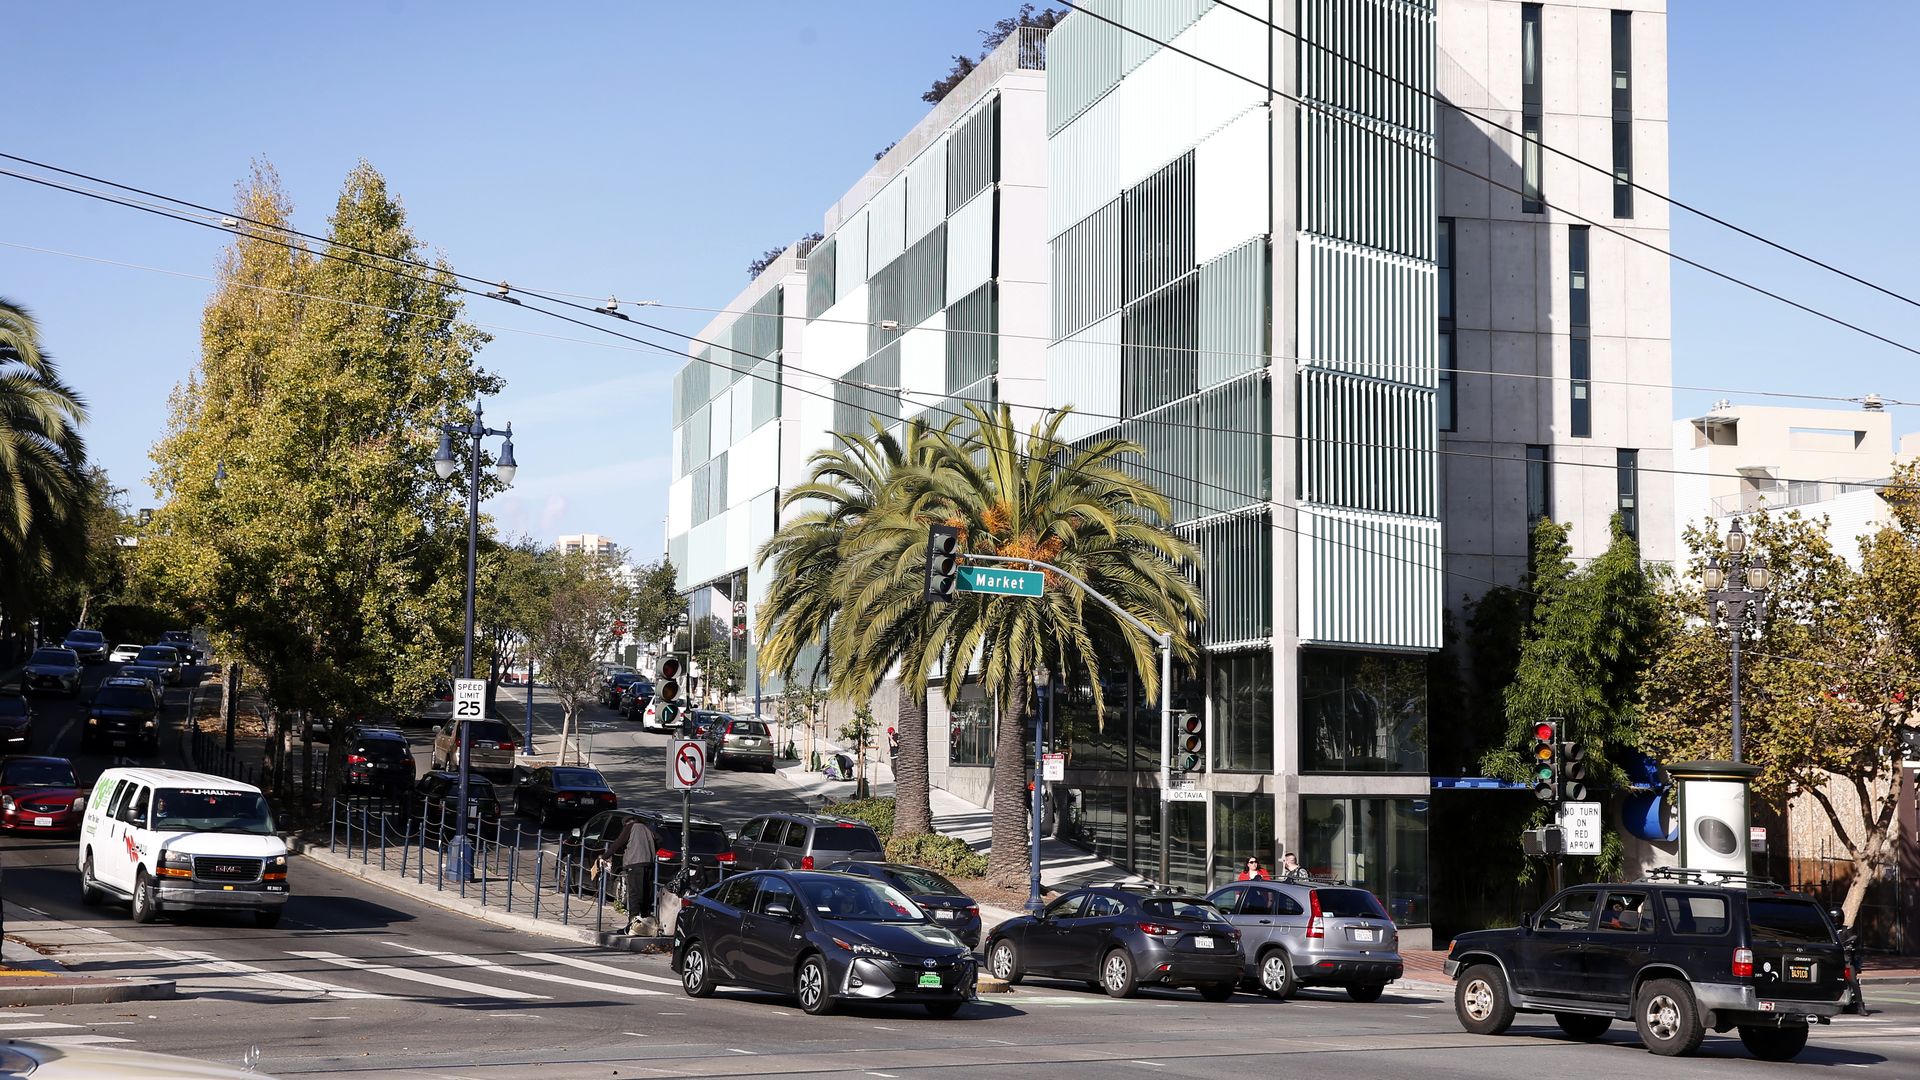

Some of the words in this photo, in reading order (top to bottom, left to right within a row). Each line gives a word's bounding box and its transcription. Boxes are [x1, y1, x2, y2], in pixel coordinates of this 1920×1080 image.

[976, 573, 1025, 590] Market
[457, 683, 483, 691] SPEED
[457, 700, 481, 716] 25
[1173, 791, 1204, 799] OCTAVIA
[1564, 807, 1575, 816] NO
[1580, 807, 1599, 816] TURN
[1576, 818, 1587, 827] ON
[1574, 829, 1589, 839] RED
[1569, 841, 1595, 850] ARROW
